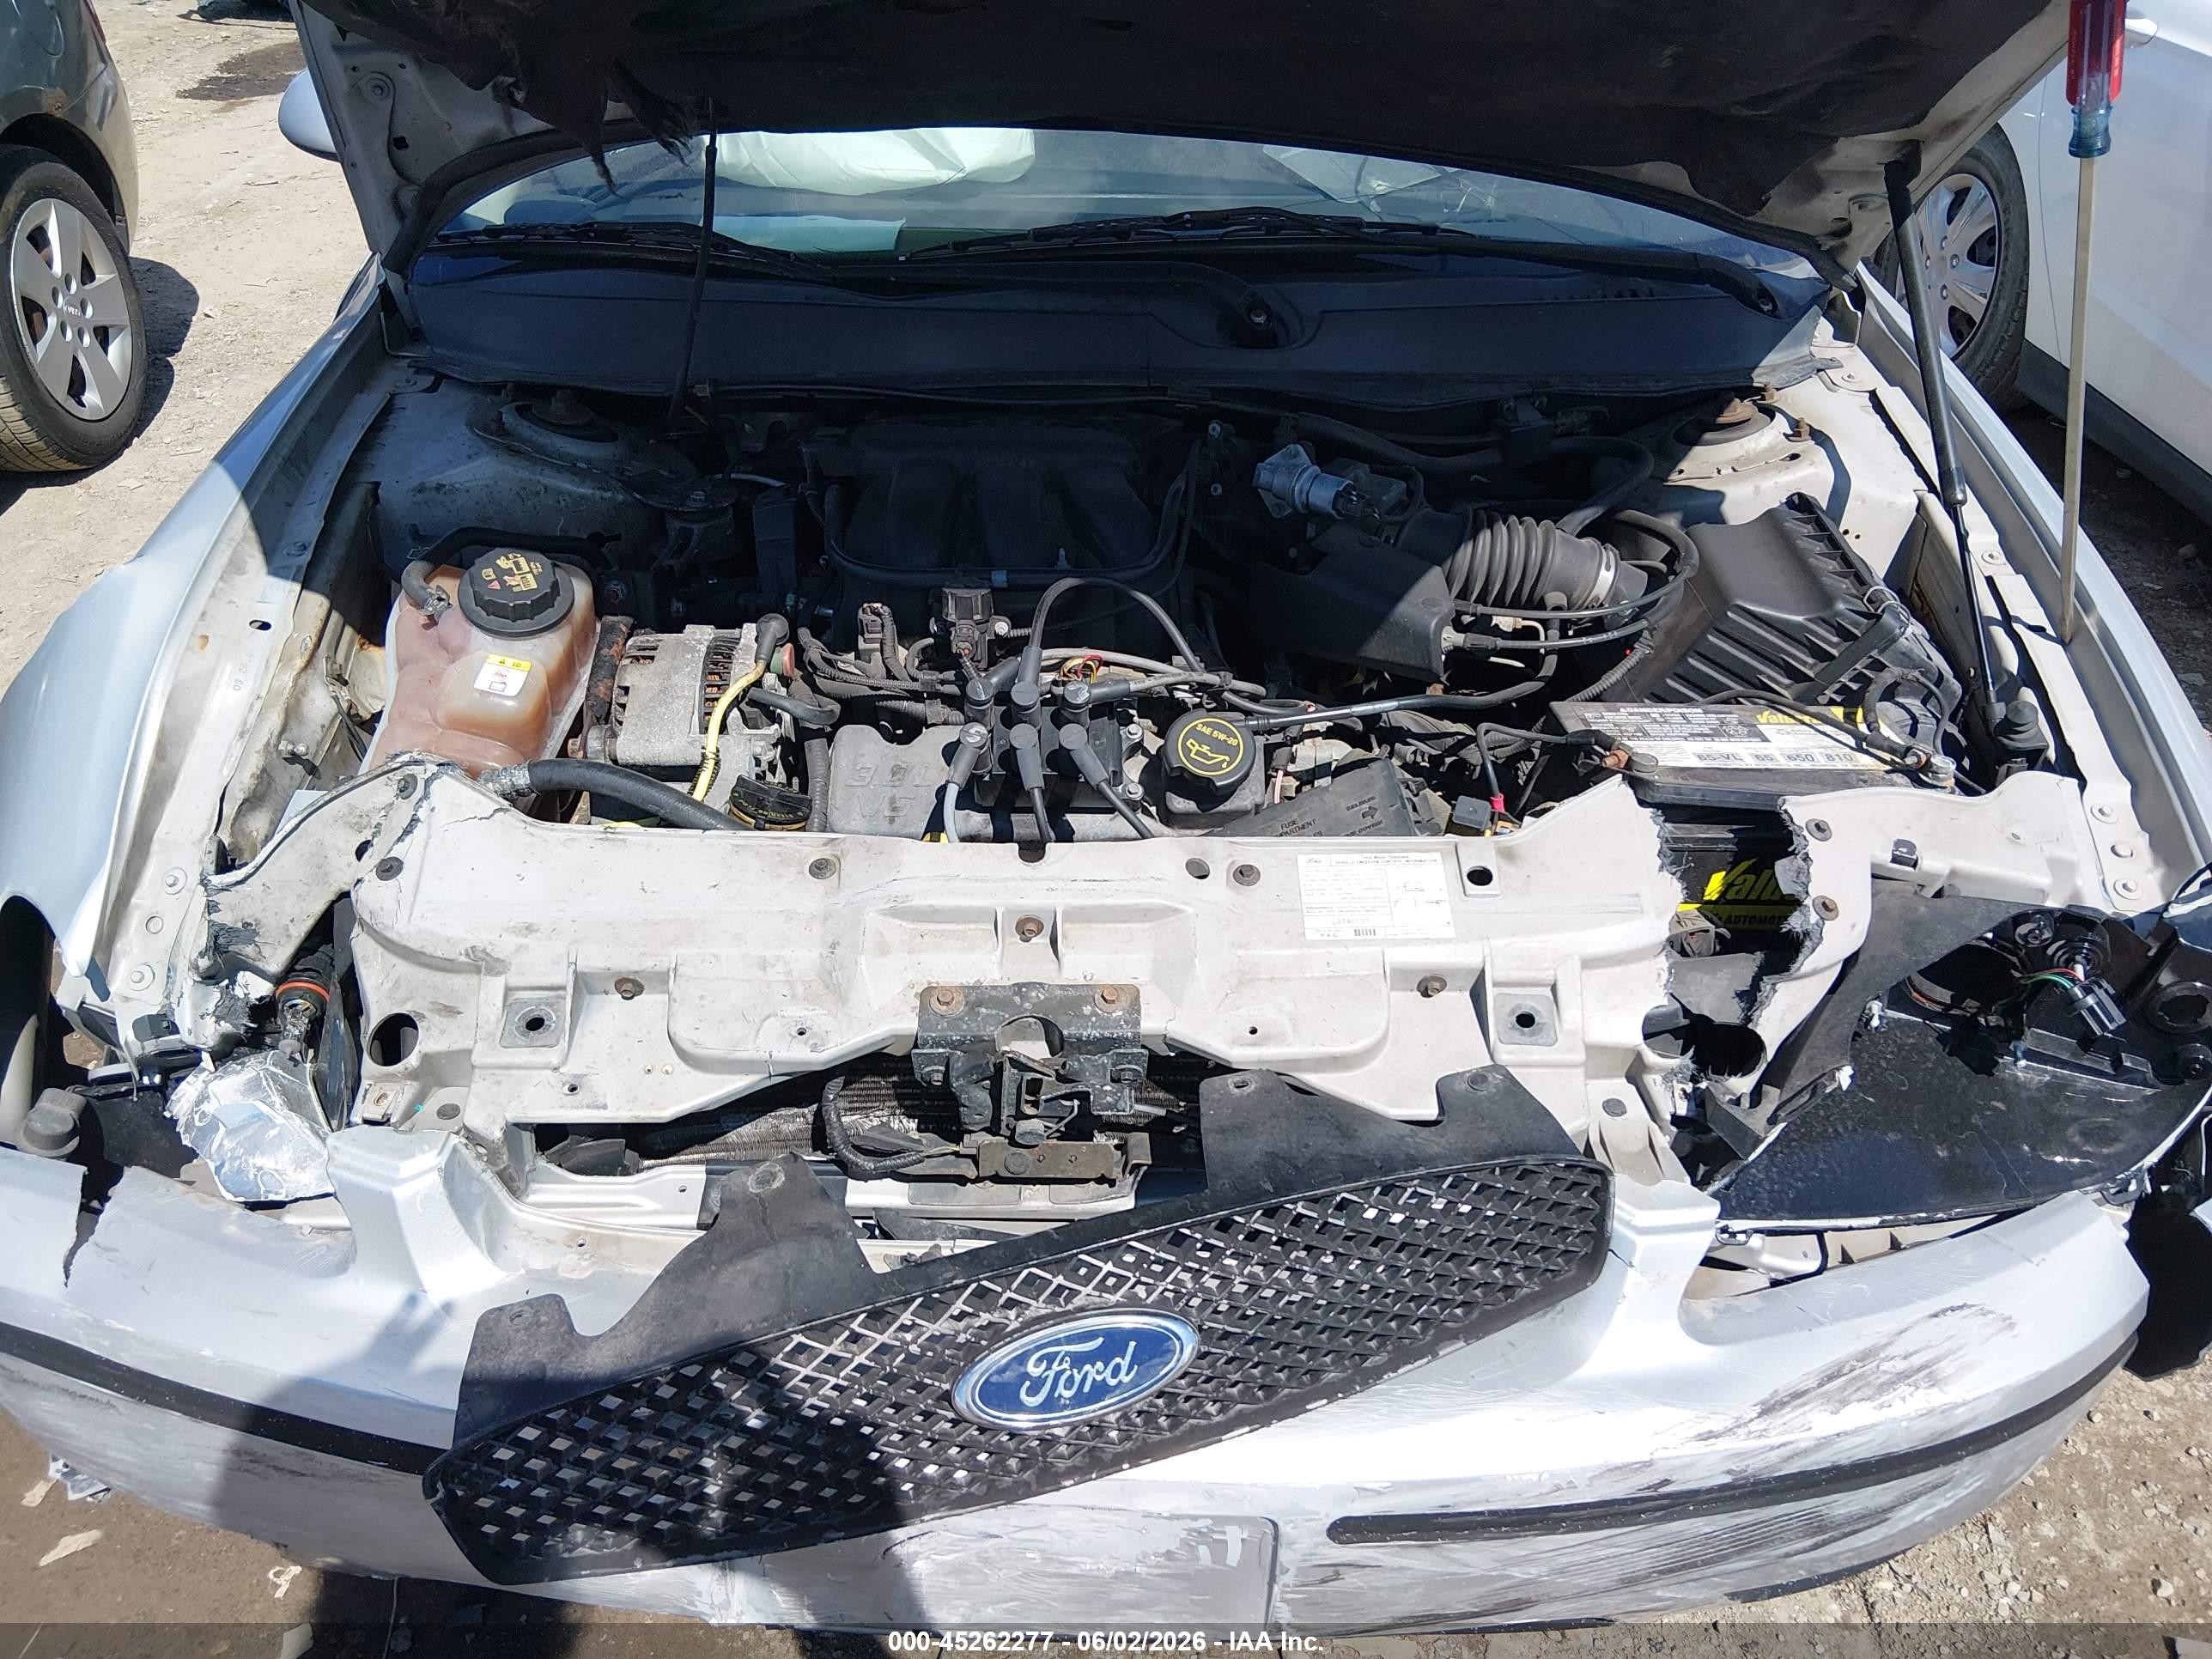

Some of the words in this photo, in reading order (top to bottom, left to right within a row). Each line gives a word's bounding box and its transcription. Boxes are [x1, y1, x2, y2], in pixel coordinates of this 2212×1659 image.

[1195, 723, 1213, 735] SAE
[1212, 730, 1239, 746] 5W-20
[1697, 753, 1743, 763] 65-VL
[1754, 753, 1775, 763] 65
[1786, 753, 1815, 763] 650
[1824, 753, 1853, 763] 810
[1019, 1335, 1137, 1407] Ford
